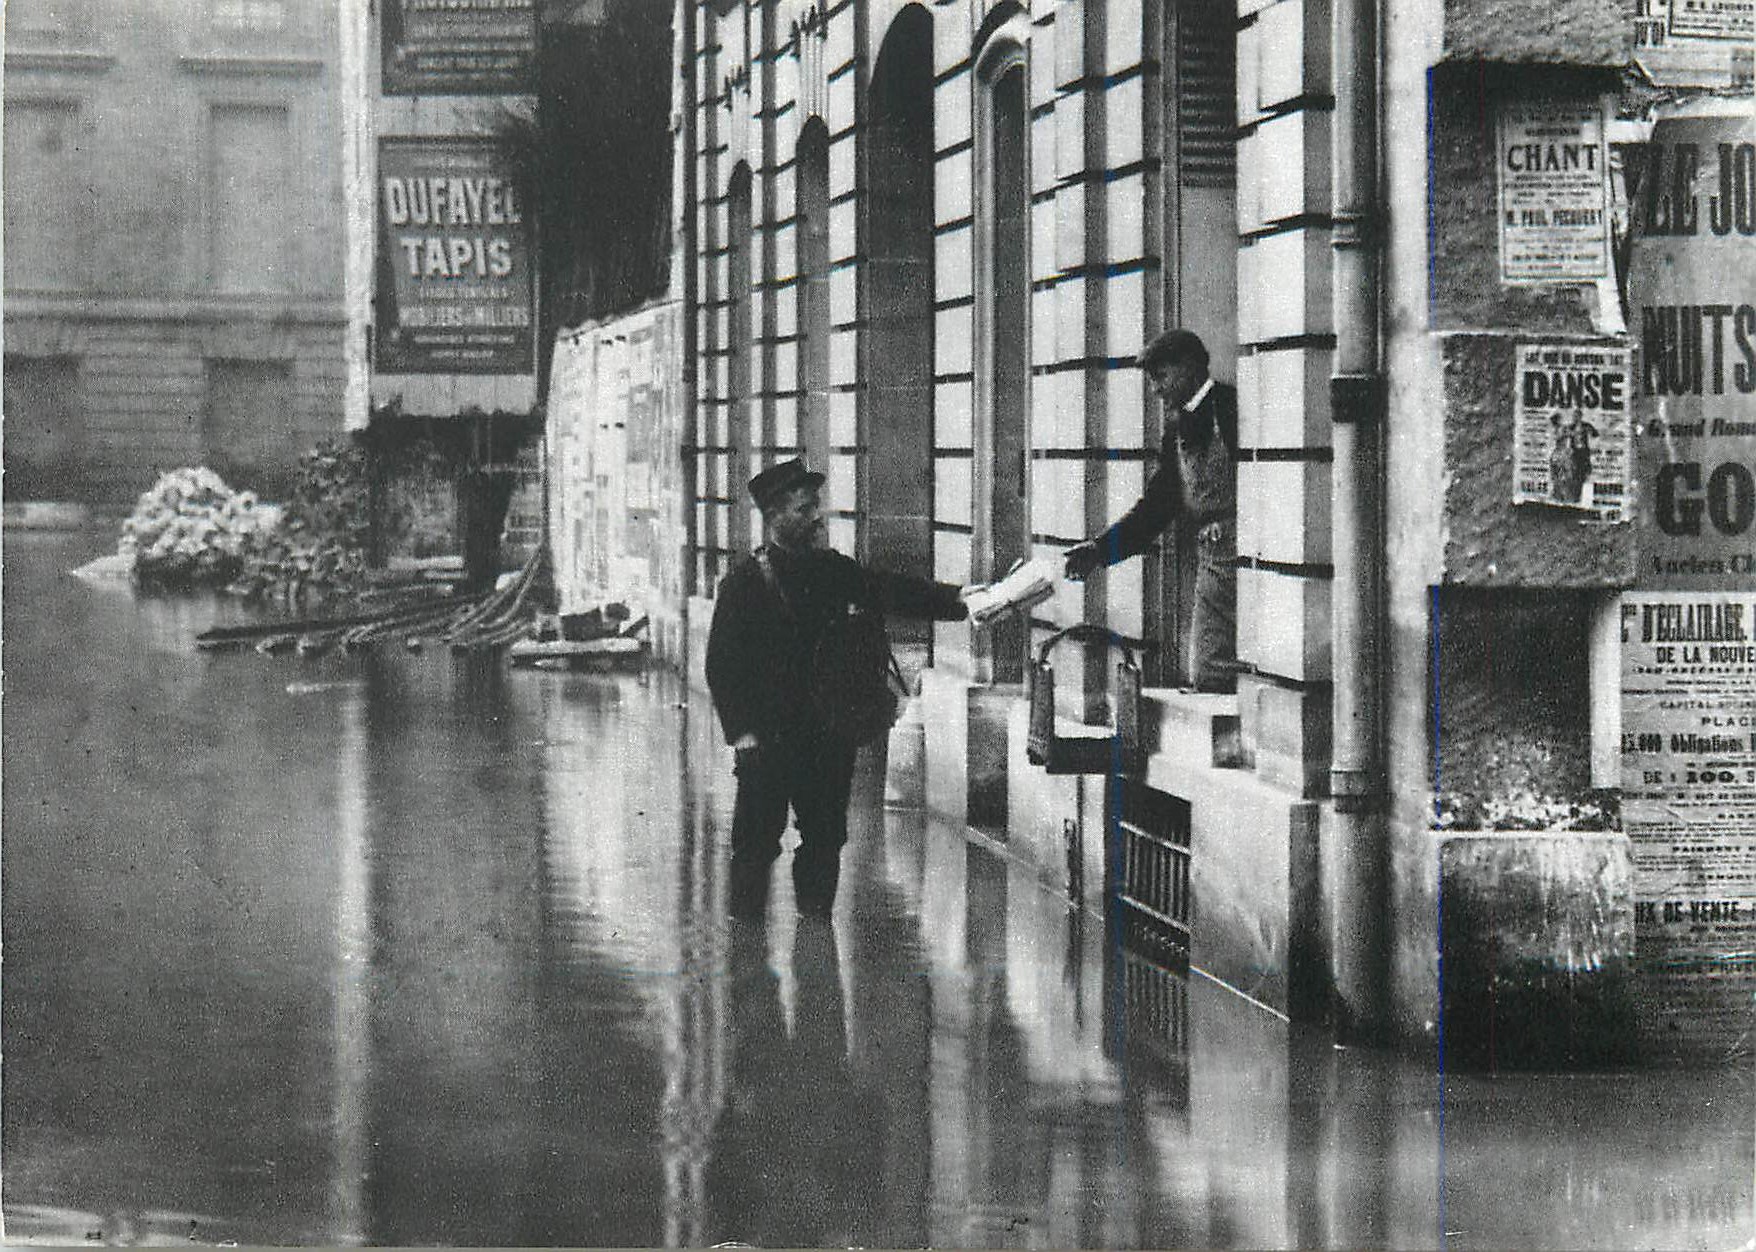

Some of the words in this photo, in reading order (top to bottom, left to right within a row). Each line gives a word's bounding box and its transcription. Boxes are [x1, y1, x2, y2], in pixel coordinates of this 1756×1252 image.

[1508, 144, 1598, 171] CHANT
[385, 178, 522, 225] DUFAYEL
[400, 237, 512, 277] TAPIS
[1523, 371, 1624, 410] DANSE
[1657, 647, 1675, 663] DE
[1683, 647, 1700, 663] LA
